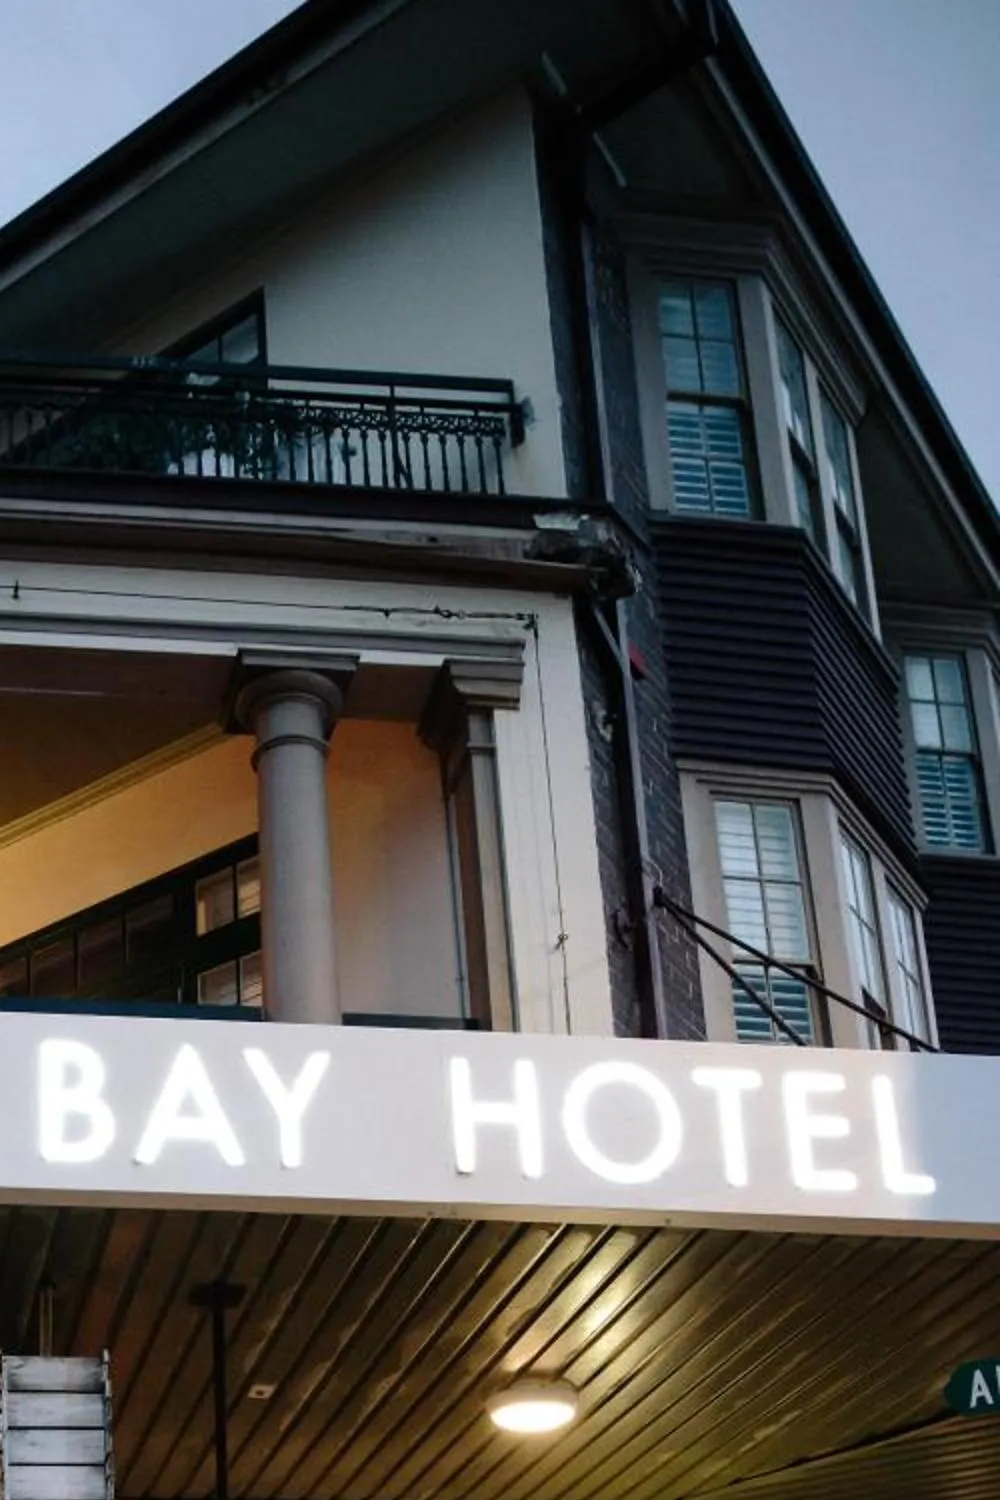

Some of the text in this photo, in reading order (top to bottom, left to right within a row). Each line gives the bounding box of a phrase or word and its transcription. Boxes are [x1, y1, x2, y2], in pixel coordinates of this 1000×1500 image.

[37, 1038, 331, 1168] BAY
[449, 1056, 936, 1195] HOTEL
[969, 1364, 1000, 1408] A
